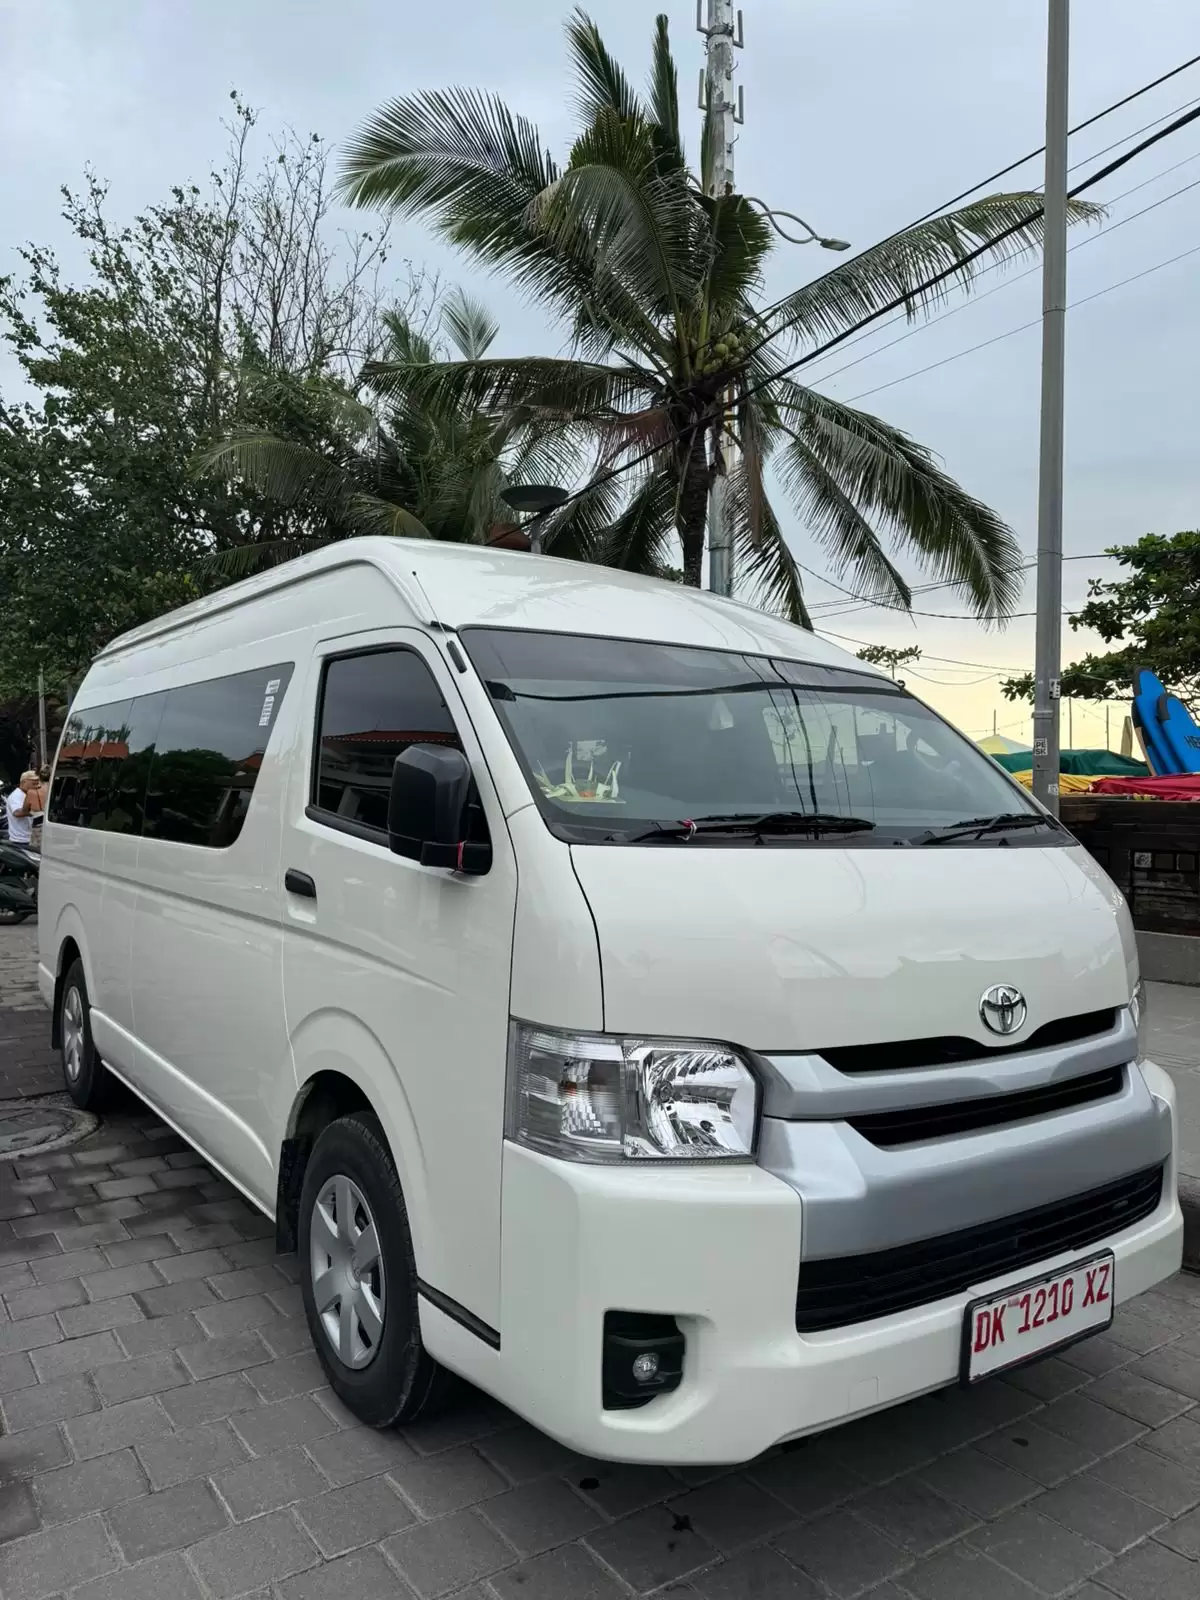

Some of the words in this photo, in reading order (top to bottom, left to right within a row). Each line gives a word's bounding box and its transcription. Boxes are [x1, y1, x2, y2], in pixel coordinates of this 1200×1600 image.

[974, 1304, 1007, 1353] DK
[1018, 1277, 1074, 1334] 1210
[1082, 1263, 1110, 1308] XZ
